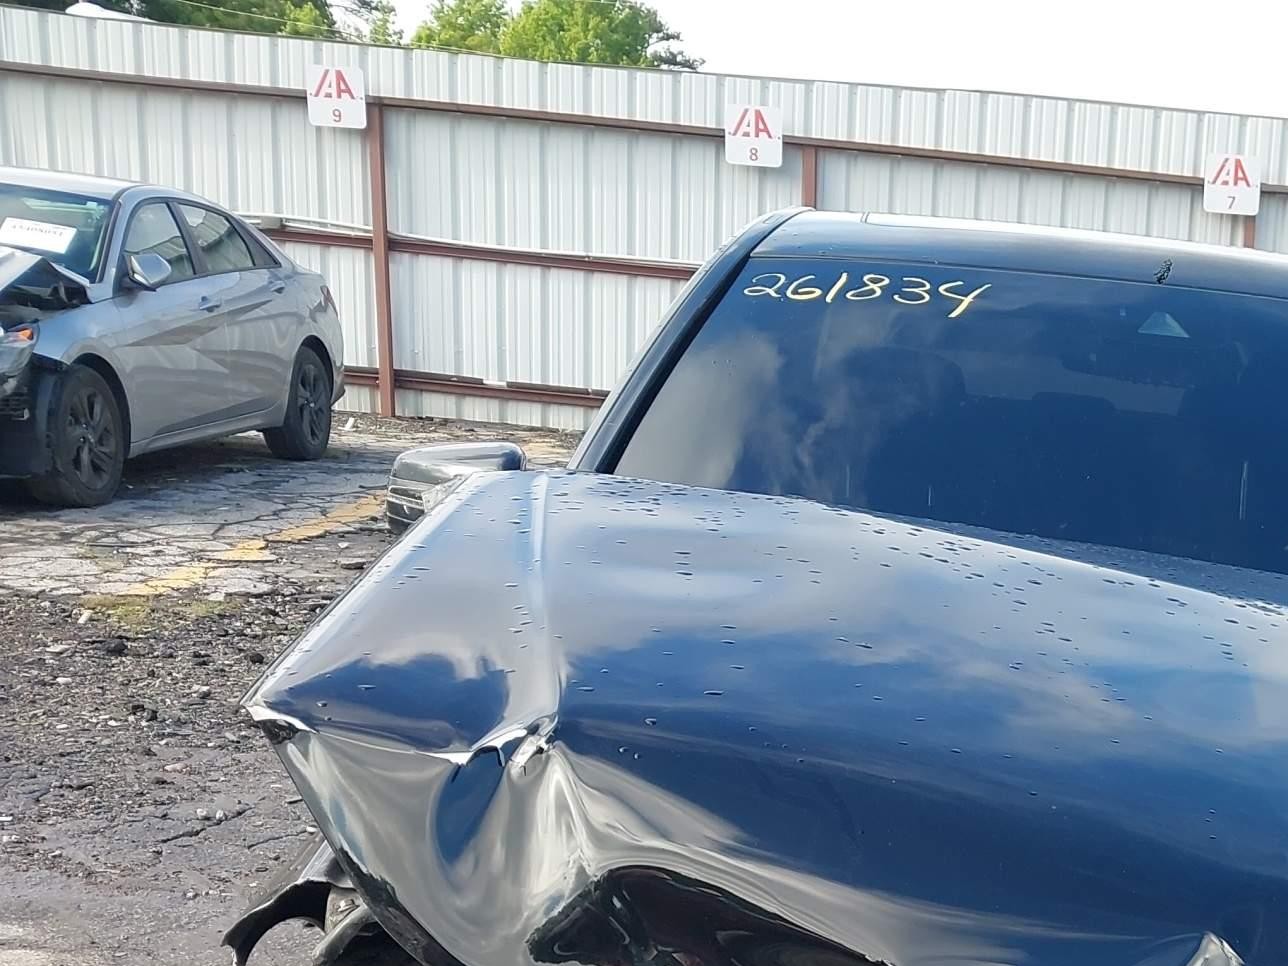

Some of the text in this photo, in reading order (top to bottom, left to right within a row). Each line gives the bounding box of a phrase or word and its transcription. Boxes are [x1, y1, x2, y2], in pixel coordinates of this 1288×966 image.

[332, 108, 342, 123] 9
[749, 147, 759, 161] 8
[1226, 195, 1236, 209] 7
[743, 272, 992, 318] 261834
